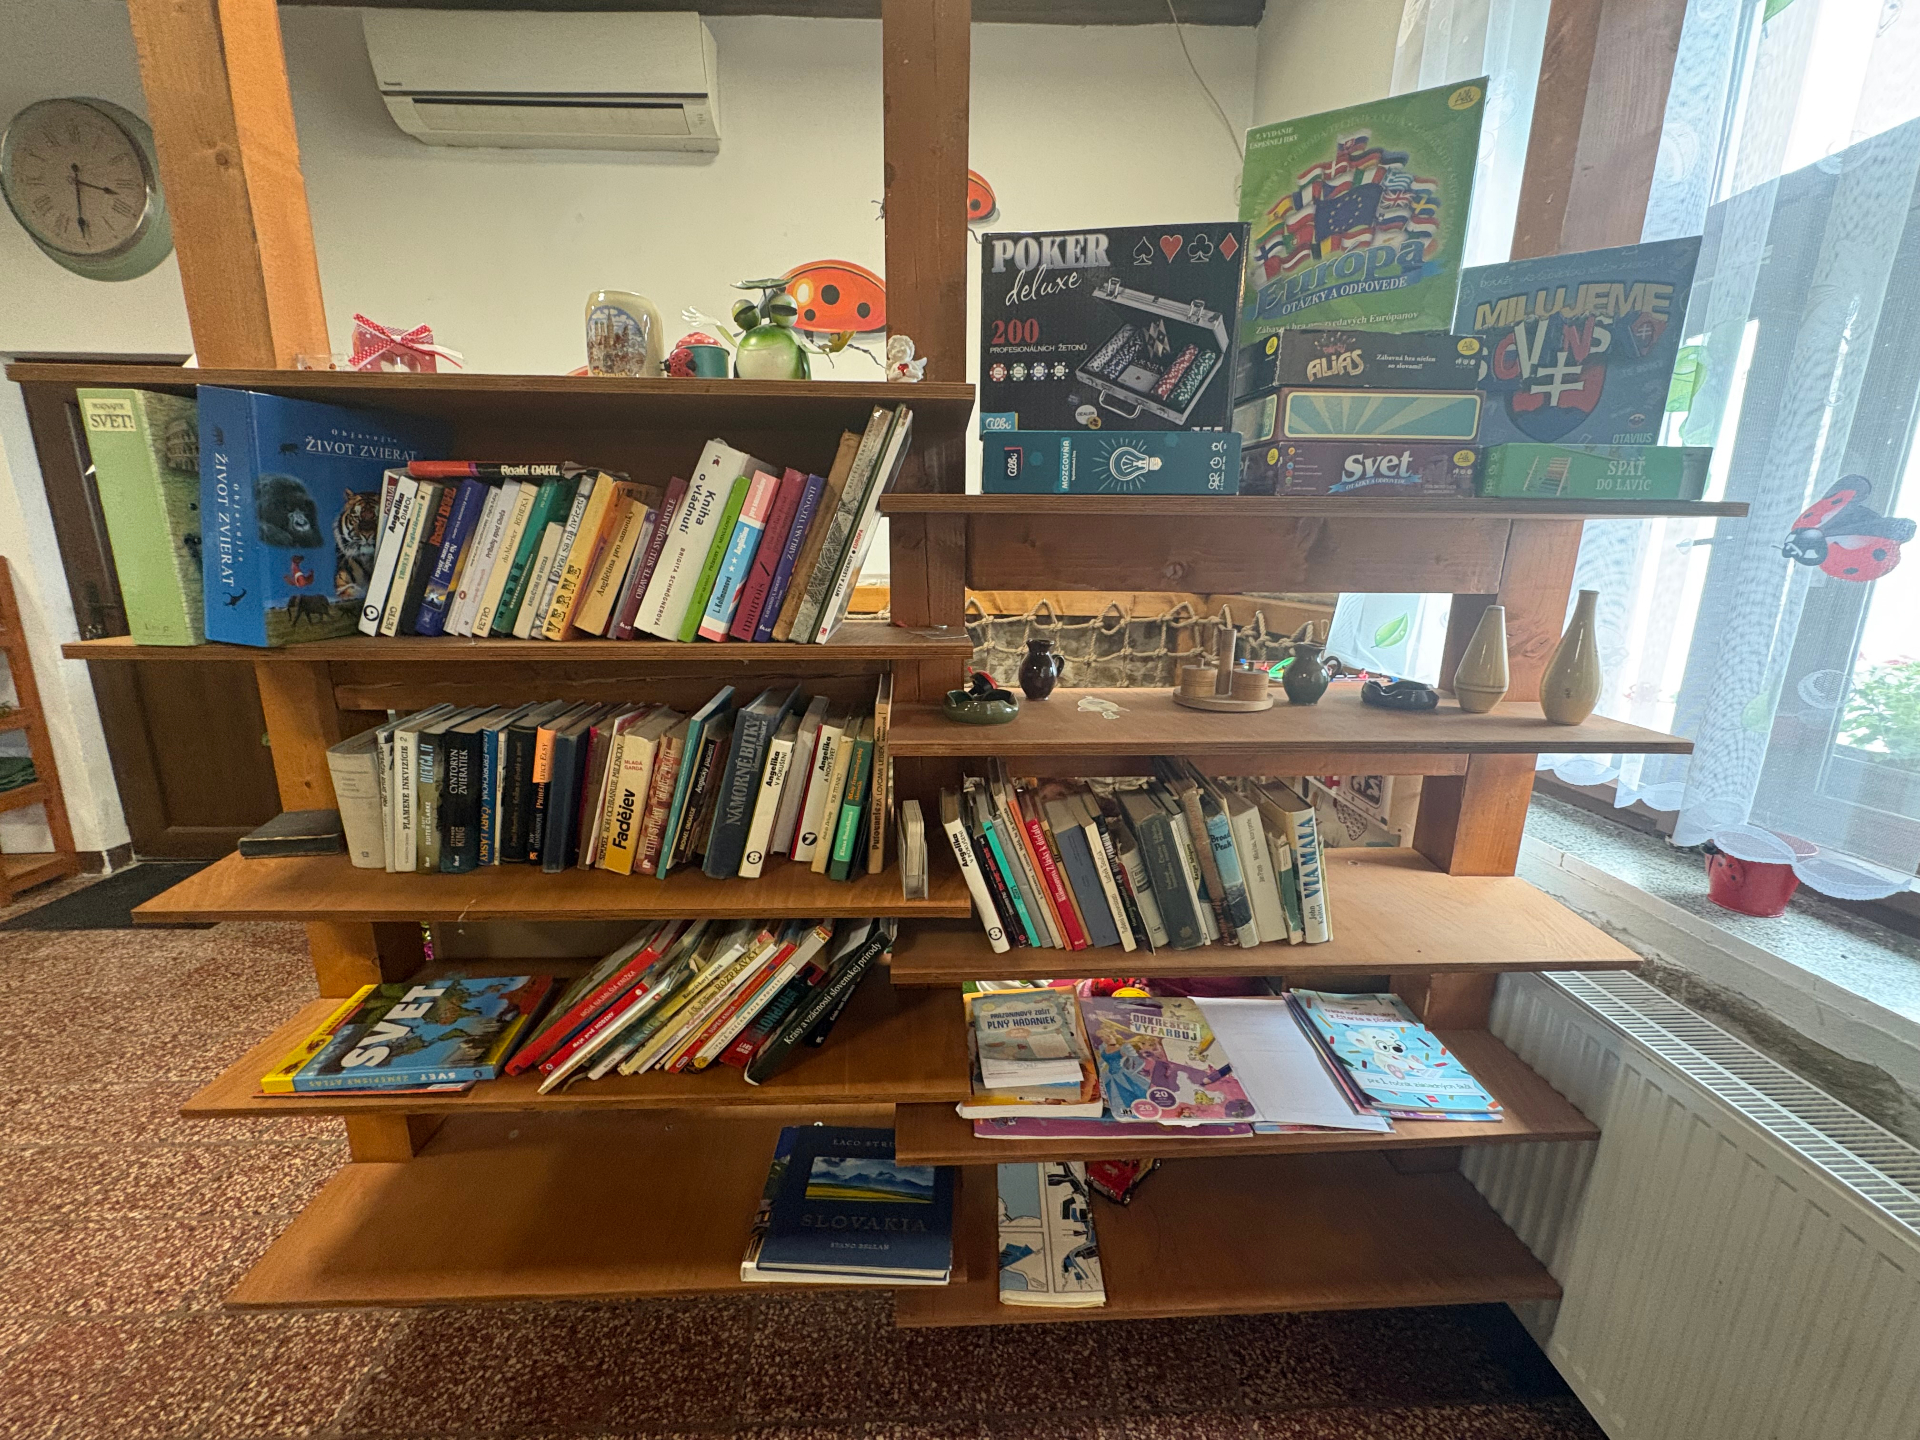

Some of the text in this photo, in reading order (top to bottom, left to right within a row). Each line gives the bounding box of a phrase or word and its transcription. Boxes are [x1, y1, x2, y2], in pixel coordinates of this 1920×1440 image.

[991, 233, 1110, 273] POKER
[1005, 263, 1082, 306] deluxe
[1252, 239, 1425, 321] Európa
[1282, 276, 1408, 316] OTÁZKY A ODPOVEDE
[1474, 282, 1674, 332] MILUJEME
[989, 342, 1087, 354] PROFESIONÁLNÍCH ŽETONŮ
[991, 318, 1039, 345] 200
[89, 413, 135, 430] SVET!
[985, 416, 1012, 430] Albi
[1612, 433, 1653, 444] OTAVIUS
[305, 436, 417, 461] ŽIVOT ZVIERAT
[1061, 440, 1070, 489] MOZGOVŇA
[1341, 450, 1414, 483] Svet
[500, 464, 561, 476] Roald DAHL
[1596, 480, 1612, 491] DO
[214, 452, 235, 587] ŽIVOT ZVIERAT
[388, 493, 405, 533] Angelika
[402, 496, 412, 520] DIABOL
[678, 473, 706, 536] o vládnutí
[696, 490, 717, 526] Kniha
[798, 485, 817, 523] VEČNOSTI
[429, 515, 447, 546] Roald
[504, 530, 518, 557] Maurier
[514, 496, 531, 528] REBEKA
[444, 551, 456, 574] druhej
[596, 511, 635, 597] Angličtina pro samouky
[635, 567, 651, 600] OBJAVTE
[646, 549, 658, 567] SILU
[653, 524, 666, 550] SVOJEJ
[842, 555, 854, 578] LEGENDY
[546, 564, 582, 634] VERNE
[652, 547, 686, 627] BRIGITA SCHMÖGNEROVÁ
[384, 606, 397, 631] RETRO
[477, 606, 491, 632] RETRO
[742, 583, 766, 633] maurois
[400, 746, 410, 790] INKVIZÍCIE
[539, 743, 549, 762] ELSY
[695, 744, 715, 794] Anglický pacient
[766, 750, 780, 787] Angelika
[778, 752, 788, 780] POKUŠENÍ
[818, 736, 832, 772] Angelika
[450, 749, 458, 794] CYNTORYN
[458, 749, 468, 794] ZVIERATIEK
[725, 716, 760, 826] NÁMORNÉ BITKY
[876, 768, 884, 795] LOVCAMI
[402, 792, 410, 830] PLAMENE
[600, 743, 625, 860] SIMMEL BOH OCHRAŇUJE MILENCOV
[612, 788, 636, 850] Fadějev
[456, 826, 466, 846] KING
[480, 806, 491, 862] ČARY LÁSKY
[645, 808, 664, 856] KEITH STUART
[679, 831, 689, 851] MICHAEL
[952, 832, 970, 868] Angelika
[960, 830, 973, 858] POKUŠENÍ
[1214, 841, 1233, 851] Peak
[1186, 844, 1198, 864] Ishiguro
[1298, 813, 1321, 898] VIA MALA
[1308, 905, 1316, 920] John
[714, 947, 760, 992] ROZPRÁVKY
[580, 968, 637, 1018] MOJA NAJMILŠIA KNIŽKA
[783, 1023, 805, 1046] Krásy
[803, 993, 832, 1024] vzácnosti
[827, 962, 862, 999] slovenskej
[856, 940, 883, 968] prírody
[341, 985, 451, 1069] SVET
[594, 1011, 615, 1030] HODINY
[707, 1004, 737, 1034] SUPER KNIHA
[987, 1018, 1010, 1030] PLNÝ
[1134, 1023, 1199, 1042] VYFARBUJ
[420, 1072, 455, 1080] SVET
[1153, 1090, 1168, 1098] 20
[800, 1214, 929, 1234] SLOVAKIA
